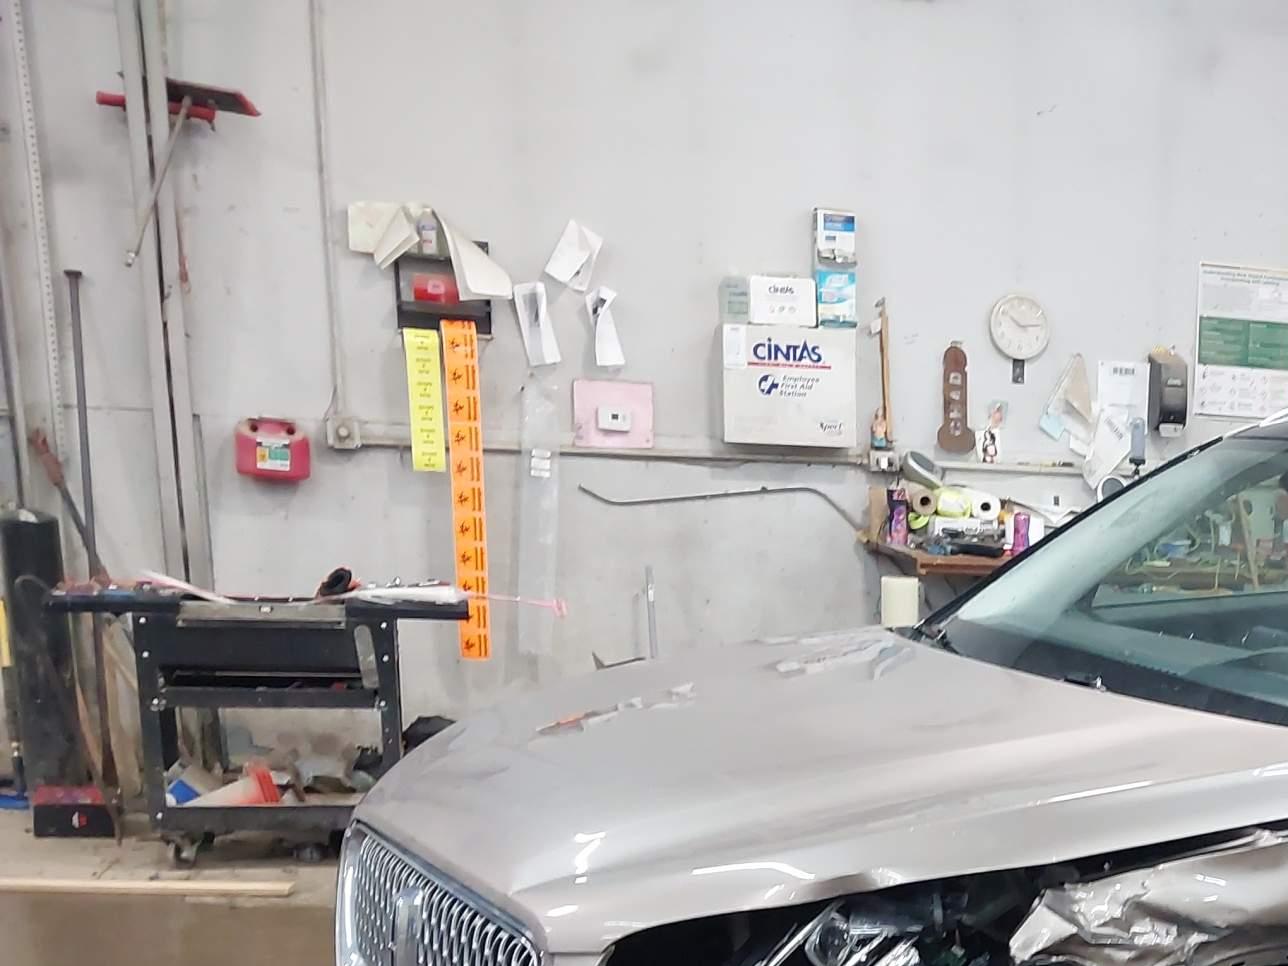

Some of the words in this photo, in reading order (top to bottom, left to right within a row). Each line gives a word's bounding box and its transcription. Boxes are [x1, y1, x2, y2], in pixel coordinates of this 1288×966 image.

[753, 337, 822, 363] CINTAS
[782, 374, 820, 385] Employee
[800, 383, 813, 391] Aid
